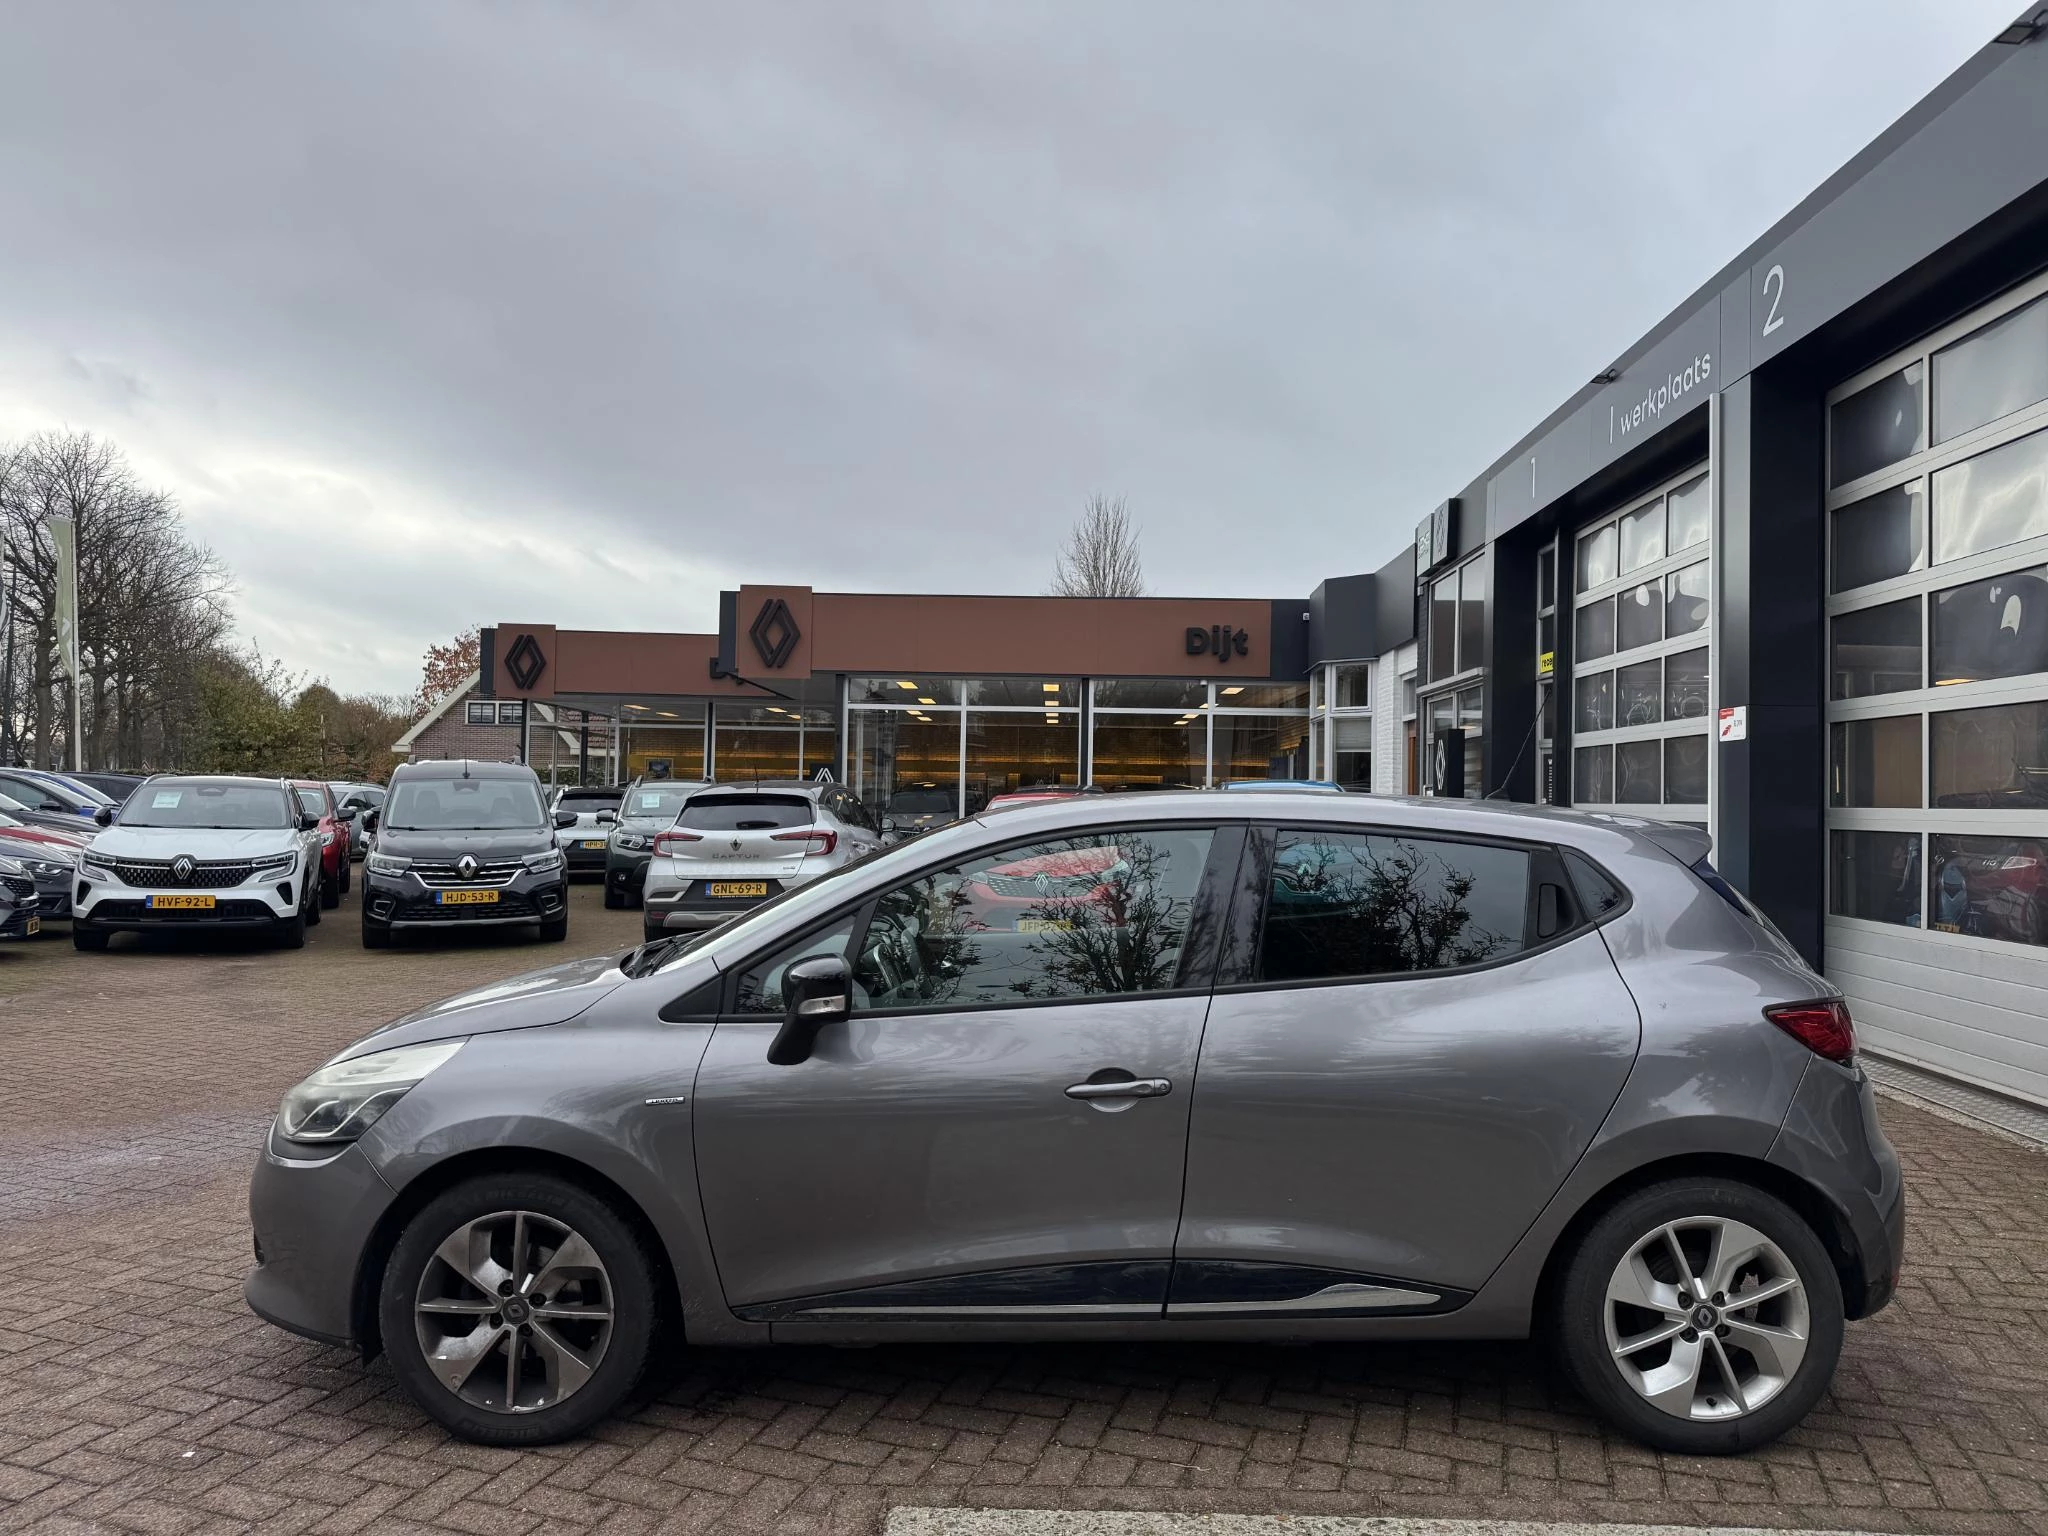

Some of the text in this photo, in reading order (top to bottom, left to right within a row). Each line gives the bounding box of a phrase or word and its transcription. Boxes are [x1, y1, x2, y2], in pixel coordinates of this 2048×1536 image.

[1763, 264, 1784, 337] 2
[1620, 353, 1711, 436] werkplaats
[1530, 457, 1536, 499] 1
[1186, 625, 1249, 662] Dijt
[158, 897, 211, 907] HVF-92-L
[446, 892, 495, 902] HJD-53-R
[713, 884, 762, 894] GNL-69-R
